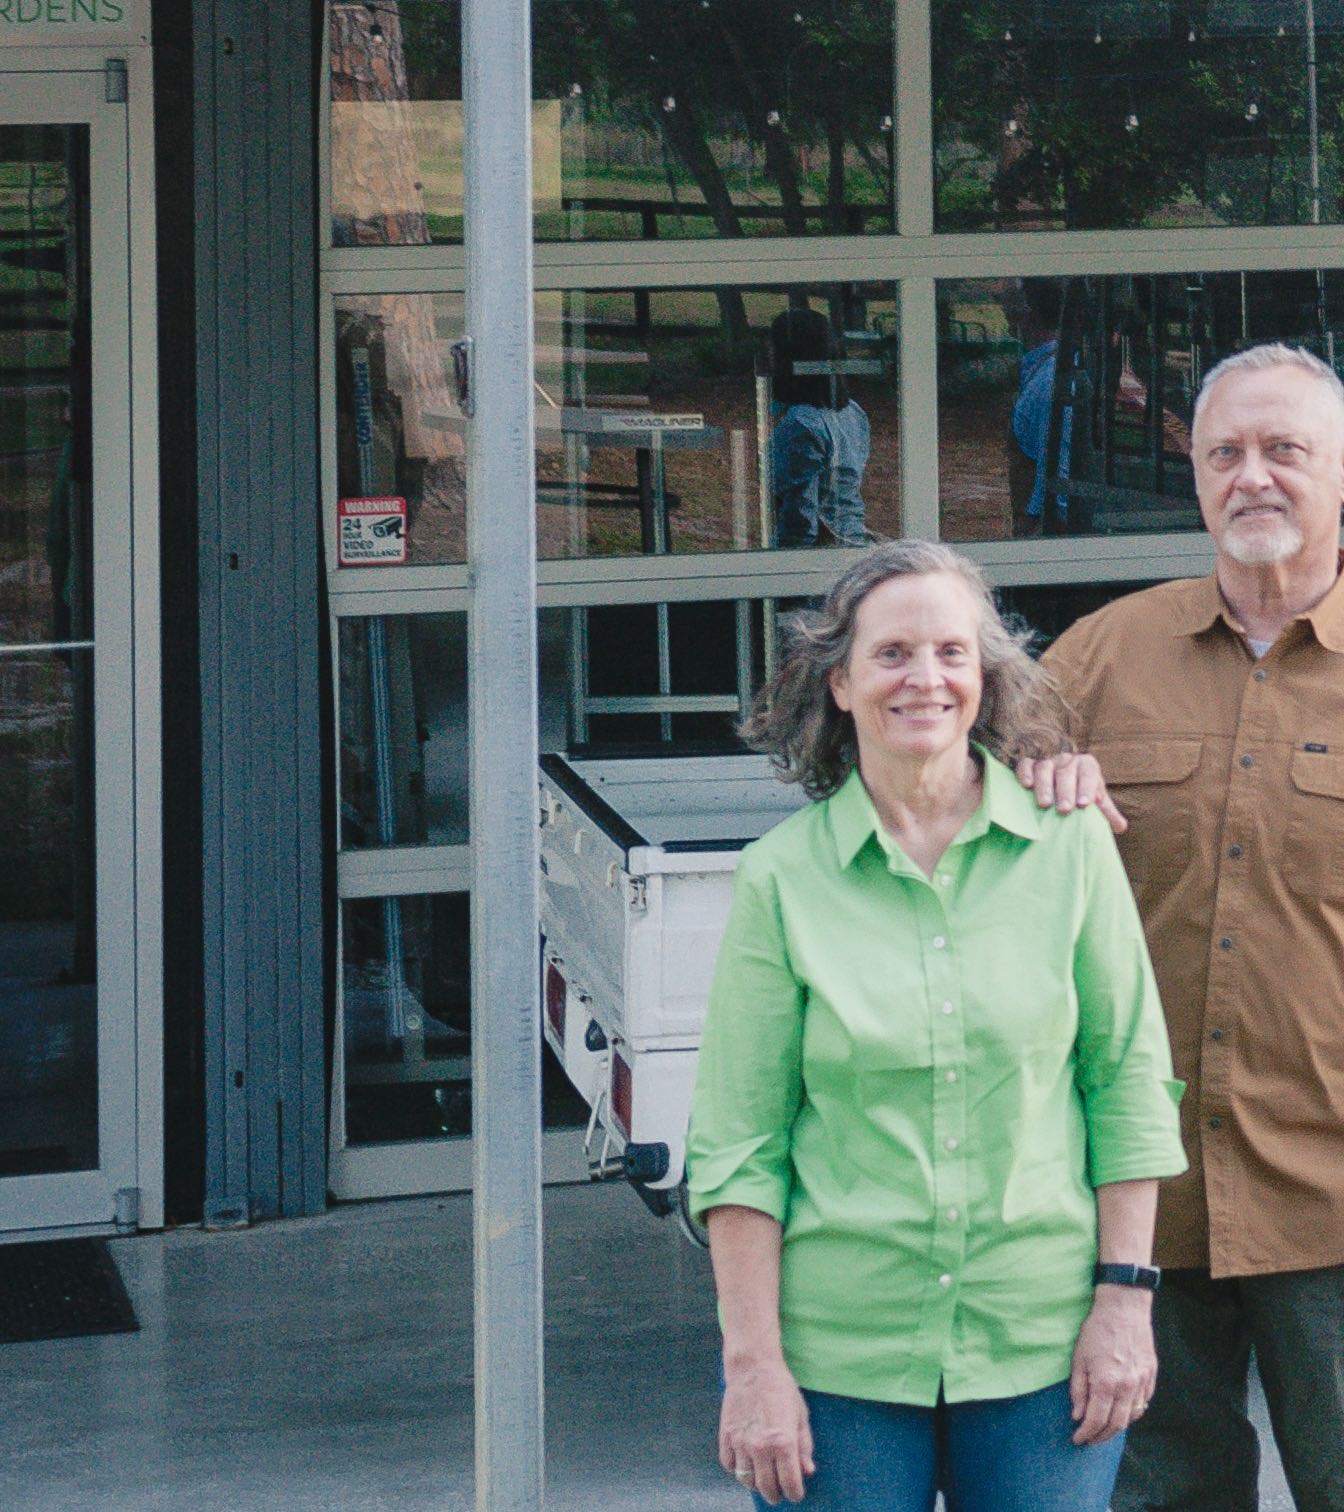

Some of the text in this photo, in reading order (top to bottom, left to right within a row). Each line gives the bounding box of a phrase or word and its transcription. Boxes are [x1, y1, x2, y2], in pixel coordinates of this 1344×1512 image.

[344, 500, 401, 514] WARNING
[342, 517, 362, 531] 24
[343, 540, 374, 550] VIDEO
